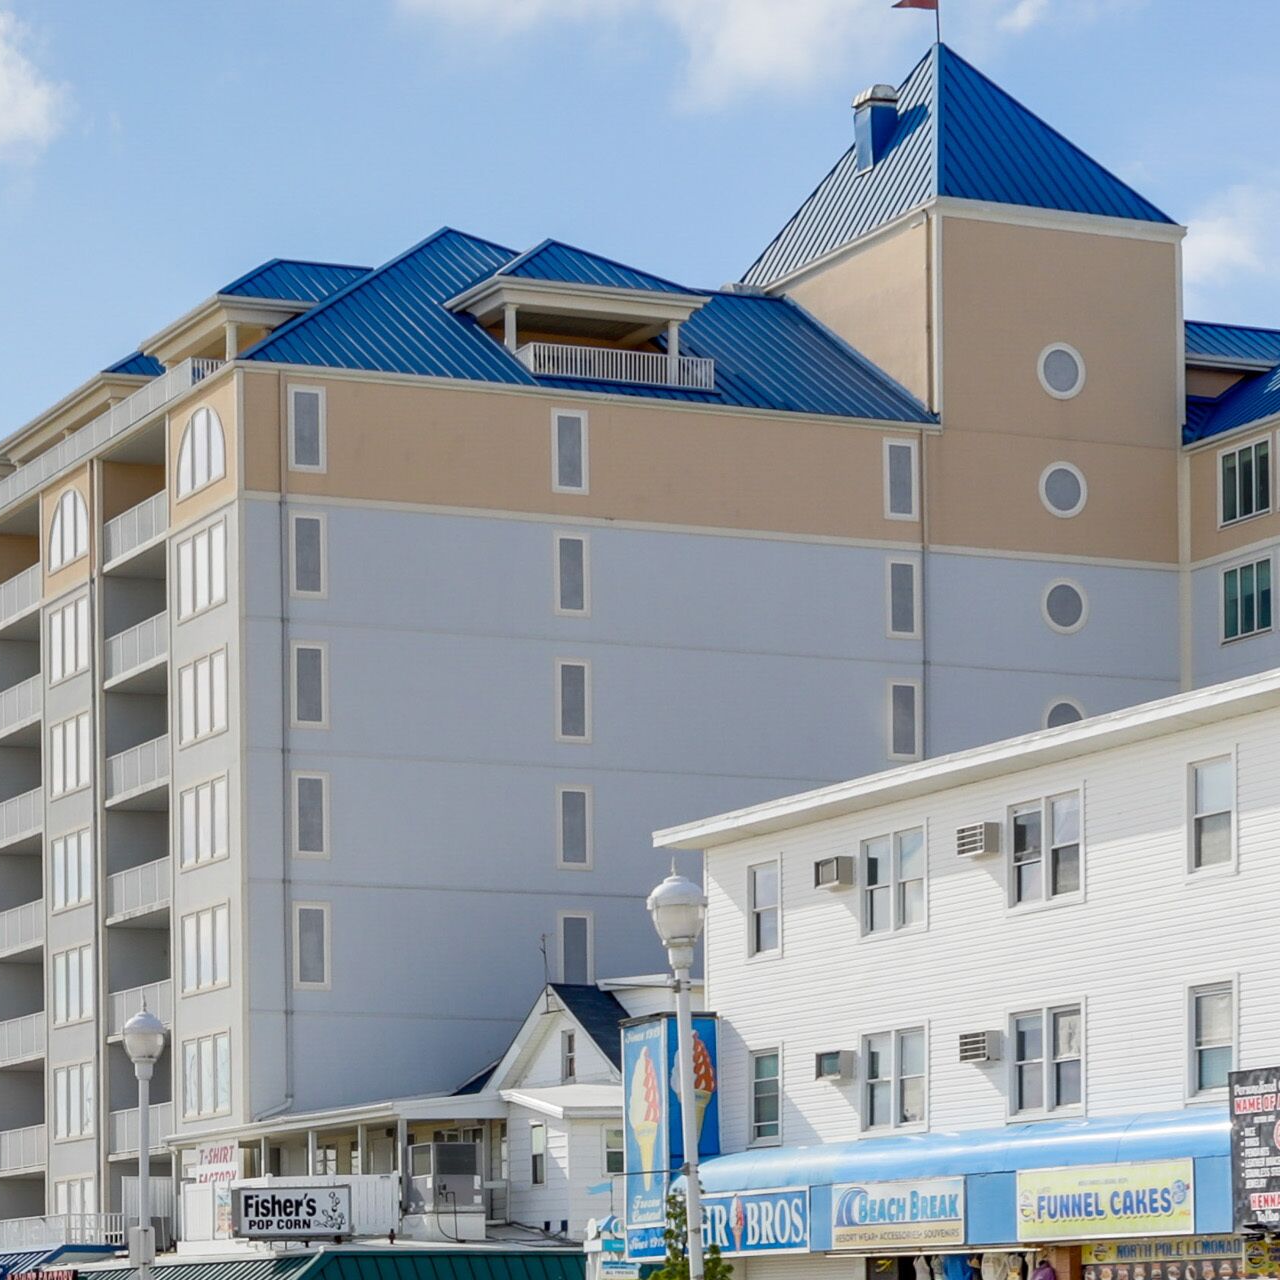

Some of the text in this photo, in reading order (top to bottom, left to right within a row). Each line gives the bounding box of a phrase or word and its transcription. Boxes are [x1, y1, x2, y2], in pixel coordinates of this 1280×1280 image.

[1235, 1096, 1262, 1114] NAME
[1263, 1094, 1276, 1112] OF
[199, 1145, 234, 1165] T-SHIRT
[244, 1192, 317, 1217] Fisher's
[858, 1189, 960, 1223] BEACH BREAK
[1036, 1187, 1172, 1220] FUNNEL CAKES
[248, 1218, 311, 1230] POP CORN
[701, 1197, 808, 1248] HR BROS.
[1117, 1238, 1242, 1259] NORTH POLE LEMONAD
